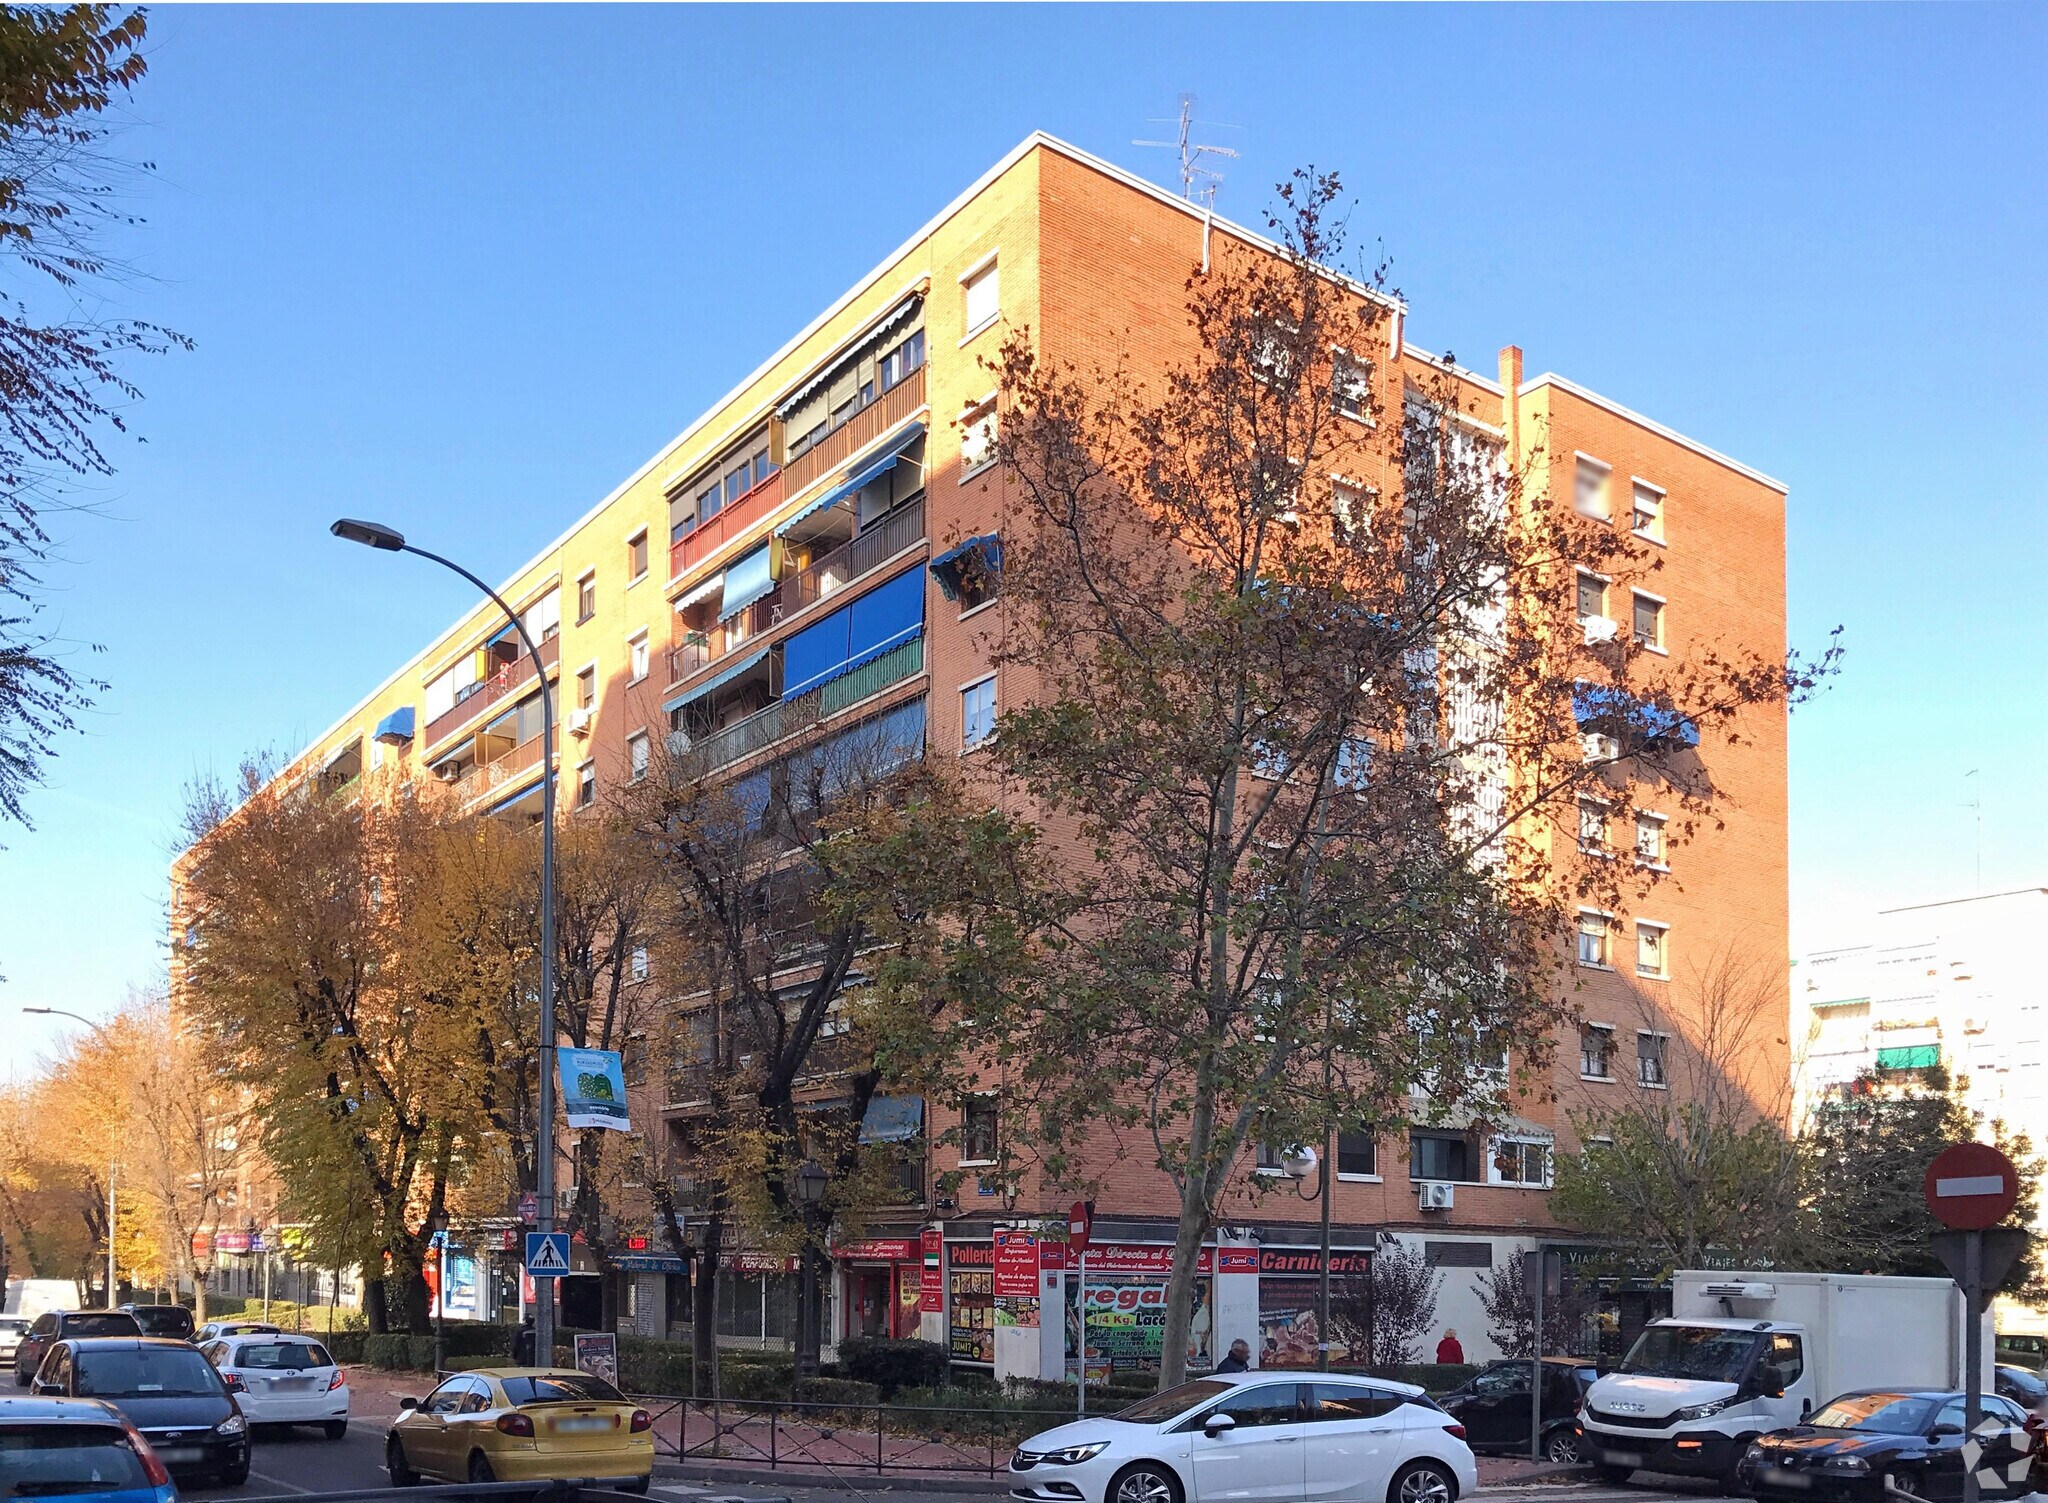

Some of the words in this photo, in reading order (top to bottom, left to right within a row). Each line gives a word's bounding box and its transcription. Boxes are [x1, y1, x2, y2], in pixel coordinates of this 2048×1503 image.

[1008, 1236, 1025, 1244] Jumi
[951, 1245, 994, 1264] Pollería
[1105, 1246, 1149, 1260] Directa
[1151, 1249, 1163, 1260] al
[1230, 1257, 1247, 1265] Jumi
[1083, 1285, 1169, 1310] regal
[1091, 1315, 1109, 1324] 1/4
[1113, 1315, 1133, 1326] Kg.
[1135, 1312, 1166, 1328] Lacó
[1610, 1401, 1647, 1413] IVECO
